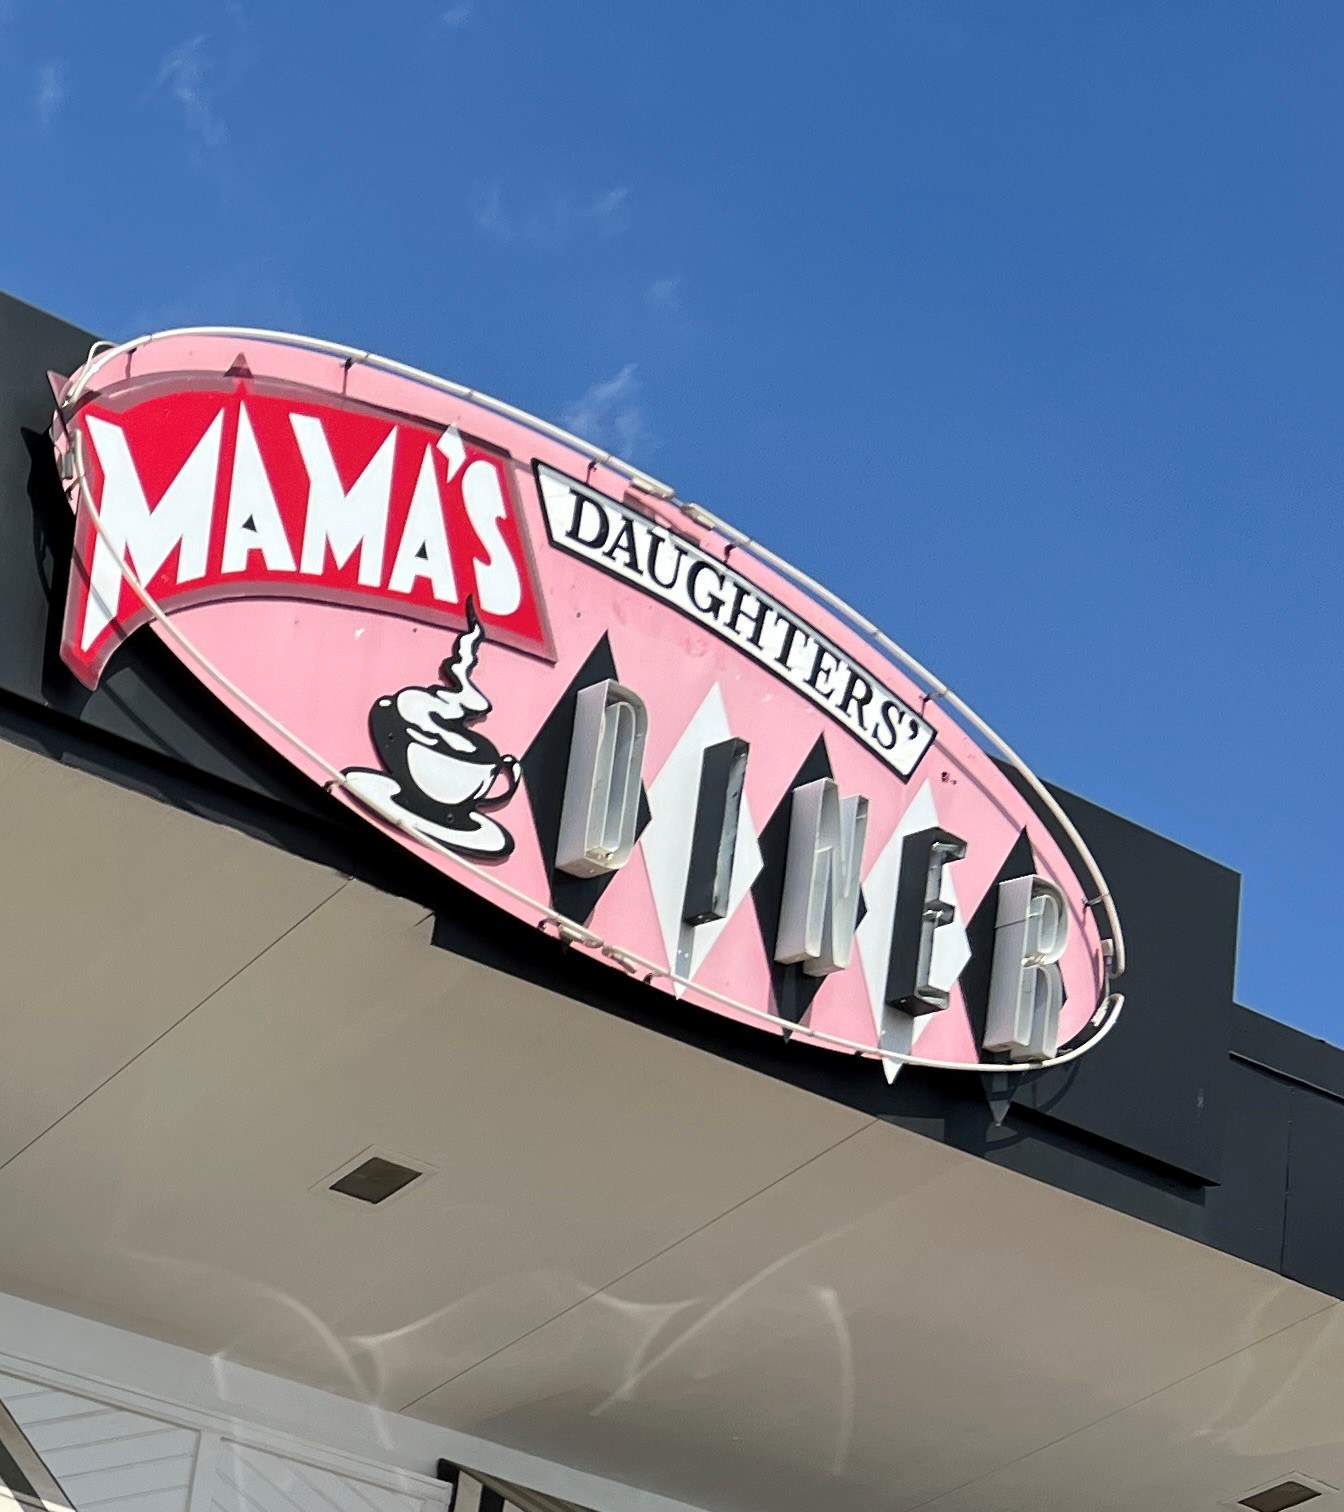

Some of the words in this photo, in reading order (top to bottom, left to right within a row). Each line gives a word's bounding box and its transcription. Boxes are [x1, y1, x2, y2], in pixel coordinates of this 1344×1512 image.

[80, 400, 524, 656] MAMA'S
[564, 486, 923, 757] DAUGHTERS'
[555, 678, 1069, 1062] DINER
